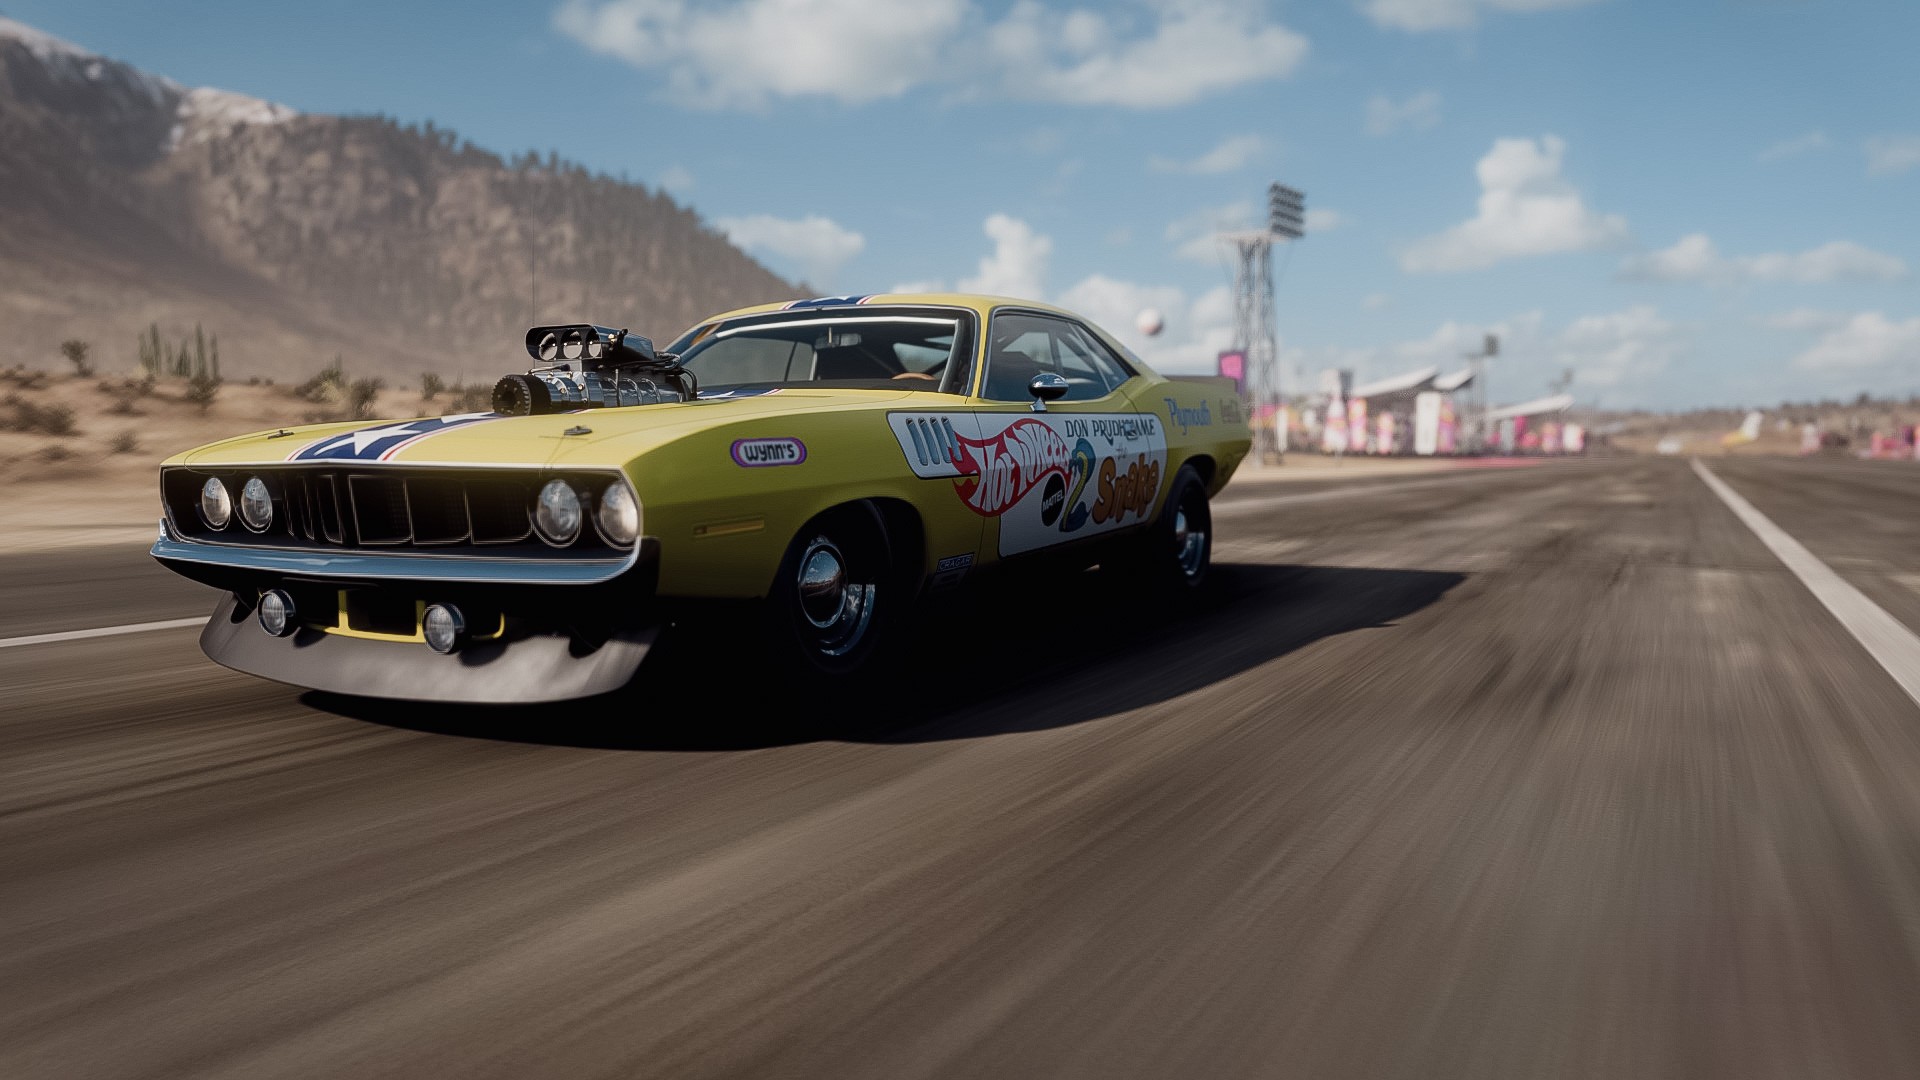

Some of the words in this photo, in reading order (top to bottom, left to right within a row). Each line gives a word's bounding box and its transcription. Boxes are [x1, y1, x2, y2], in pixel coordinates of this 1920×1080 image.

[1065, 419, 1089, 437] DON
[1092, 452, 1159, 525] Snake
[1042, 489, 1065, 512] MATTEL
